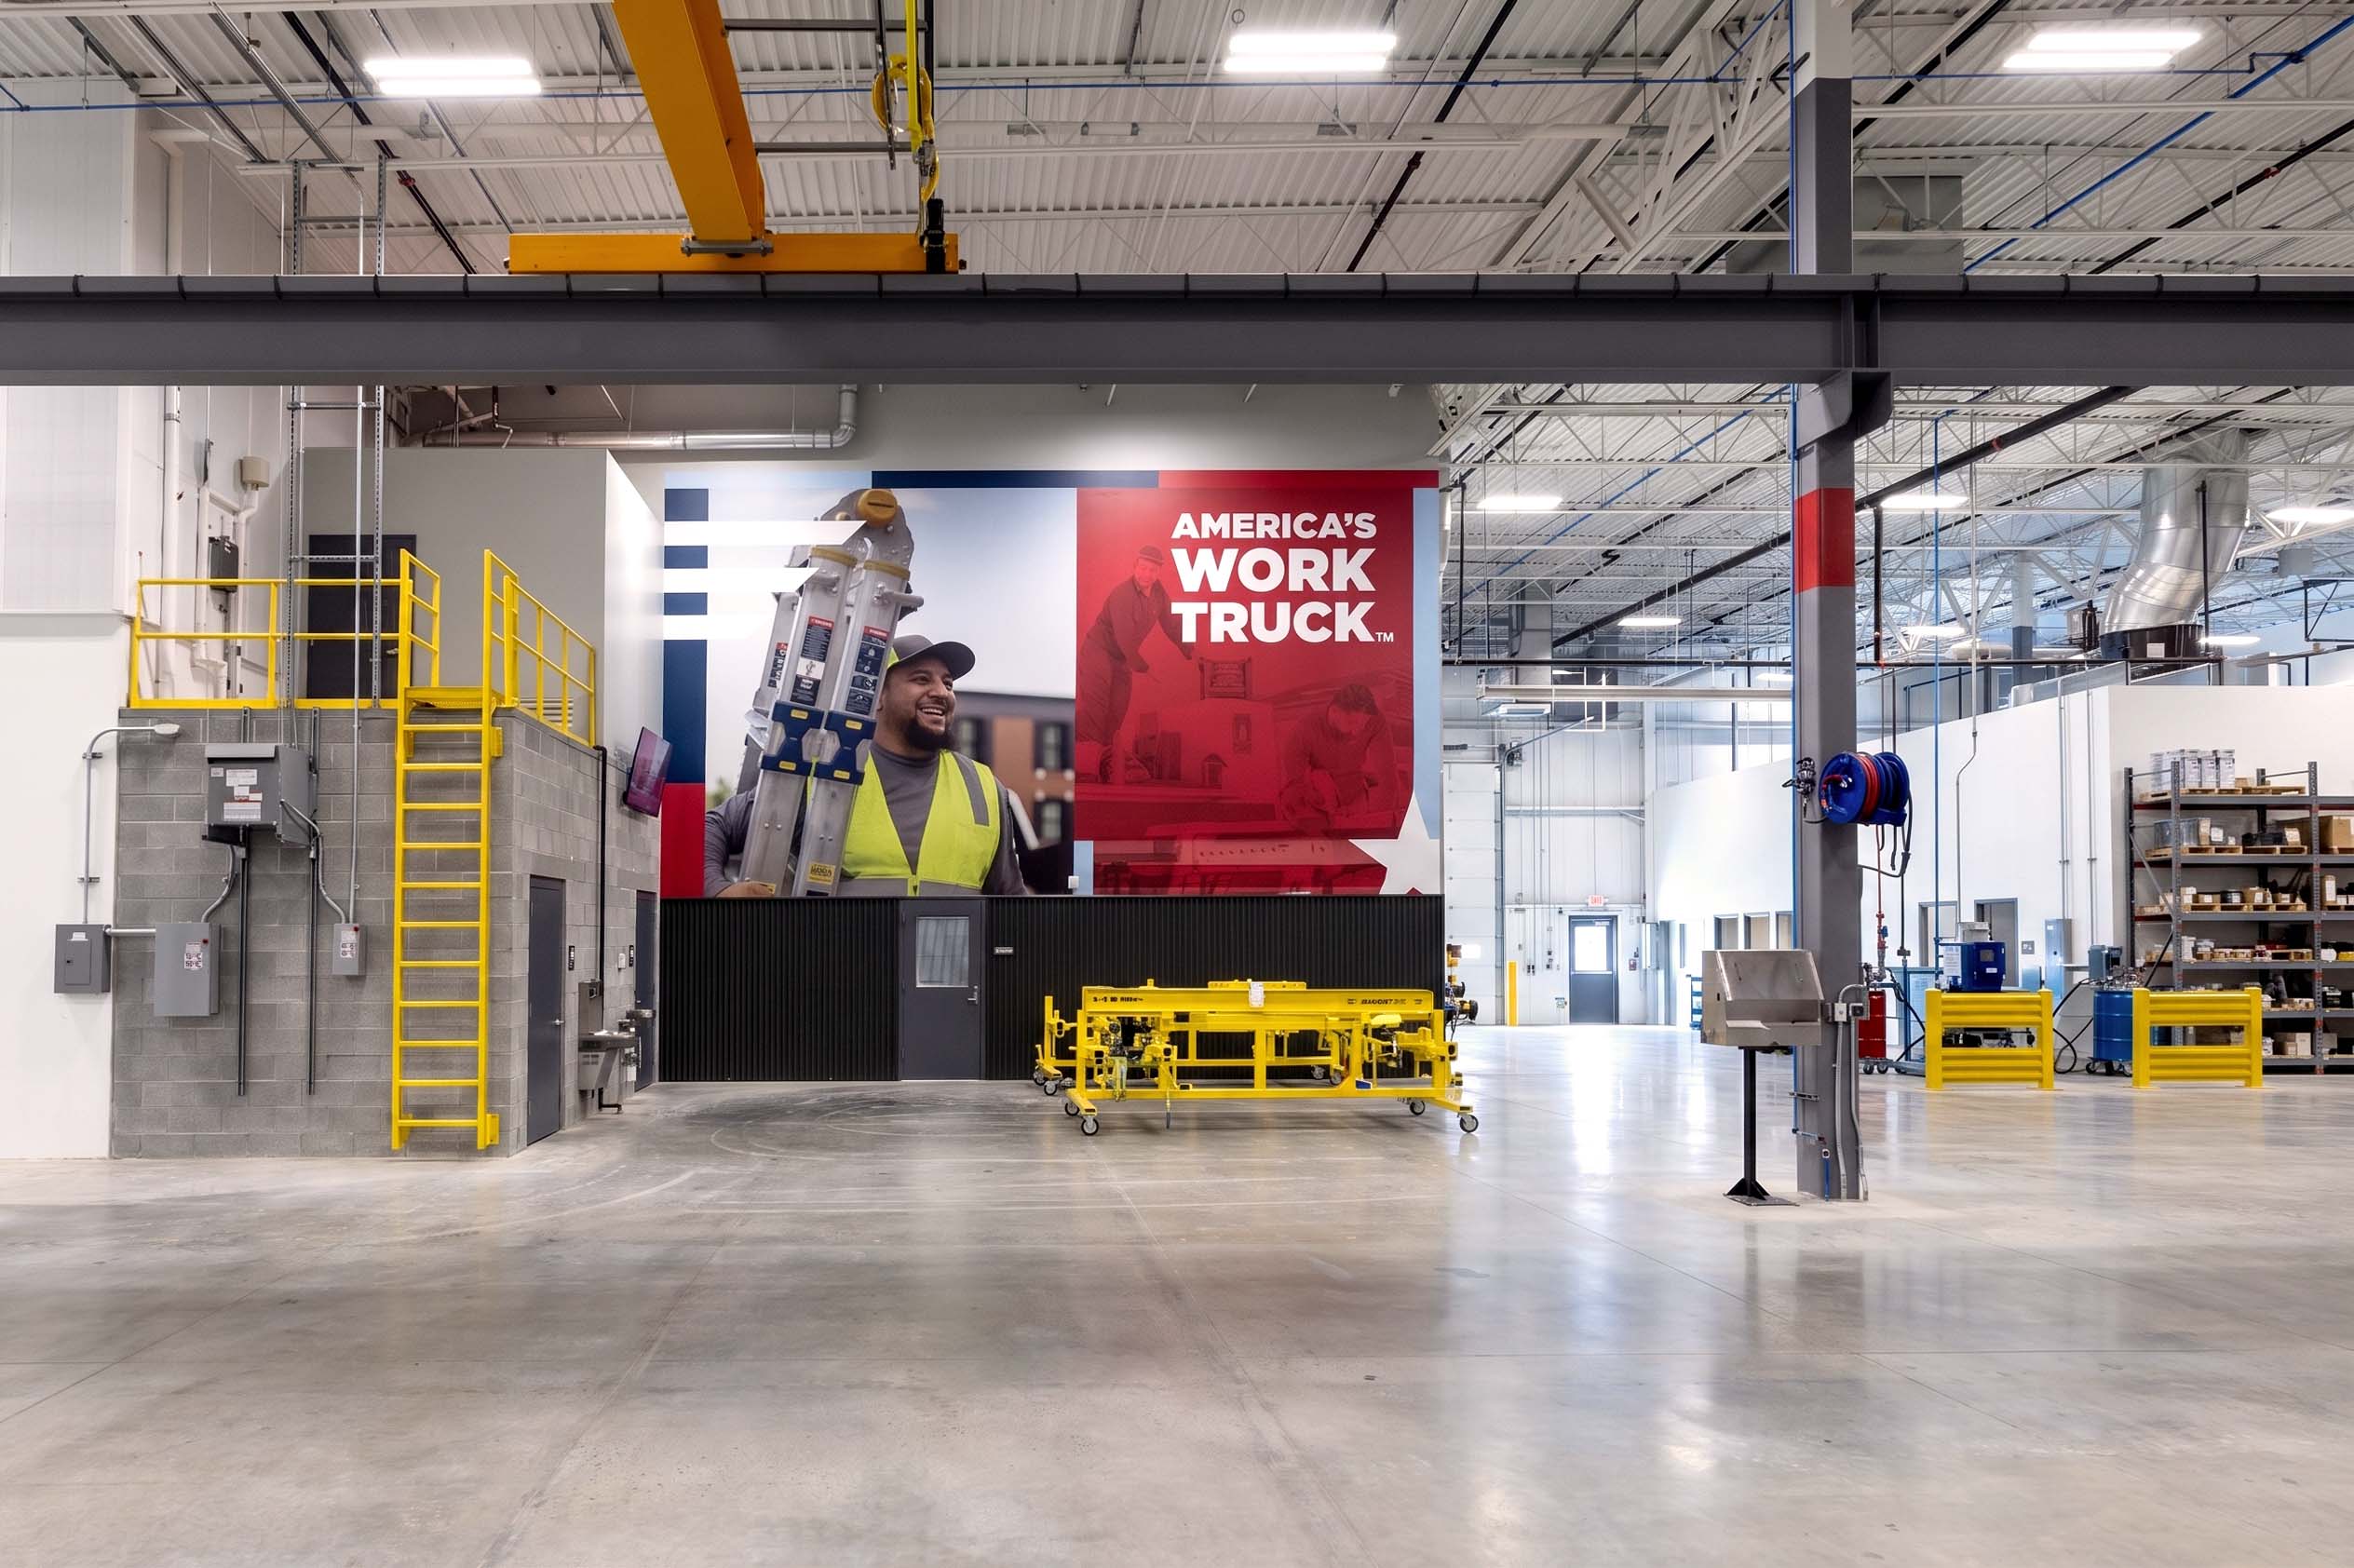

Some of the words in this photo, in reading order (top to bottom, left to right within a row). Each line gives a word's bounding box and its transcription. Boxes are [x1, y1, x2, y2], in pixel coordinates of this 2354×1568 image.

[1170, 512, 1377, 539] AMERICA'S
[1170, 547, 1376, 593] WORK
[1170, 602, 1375, 643] TRUCK
